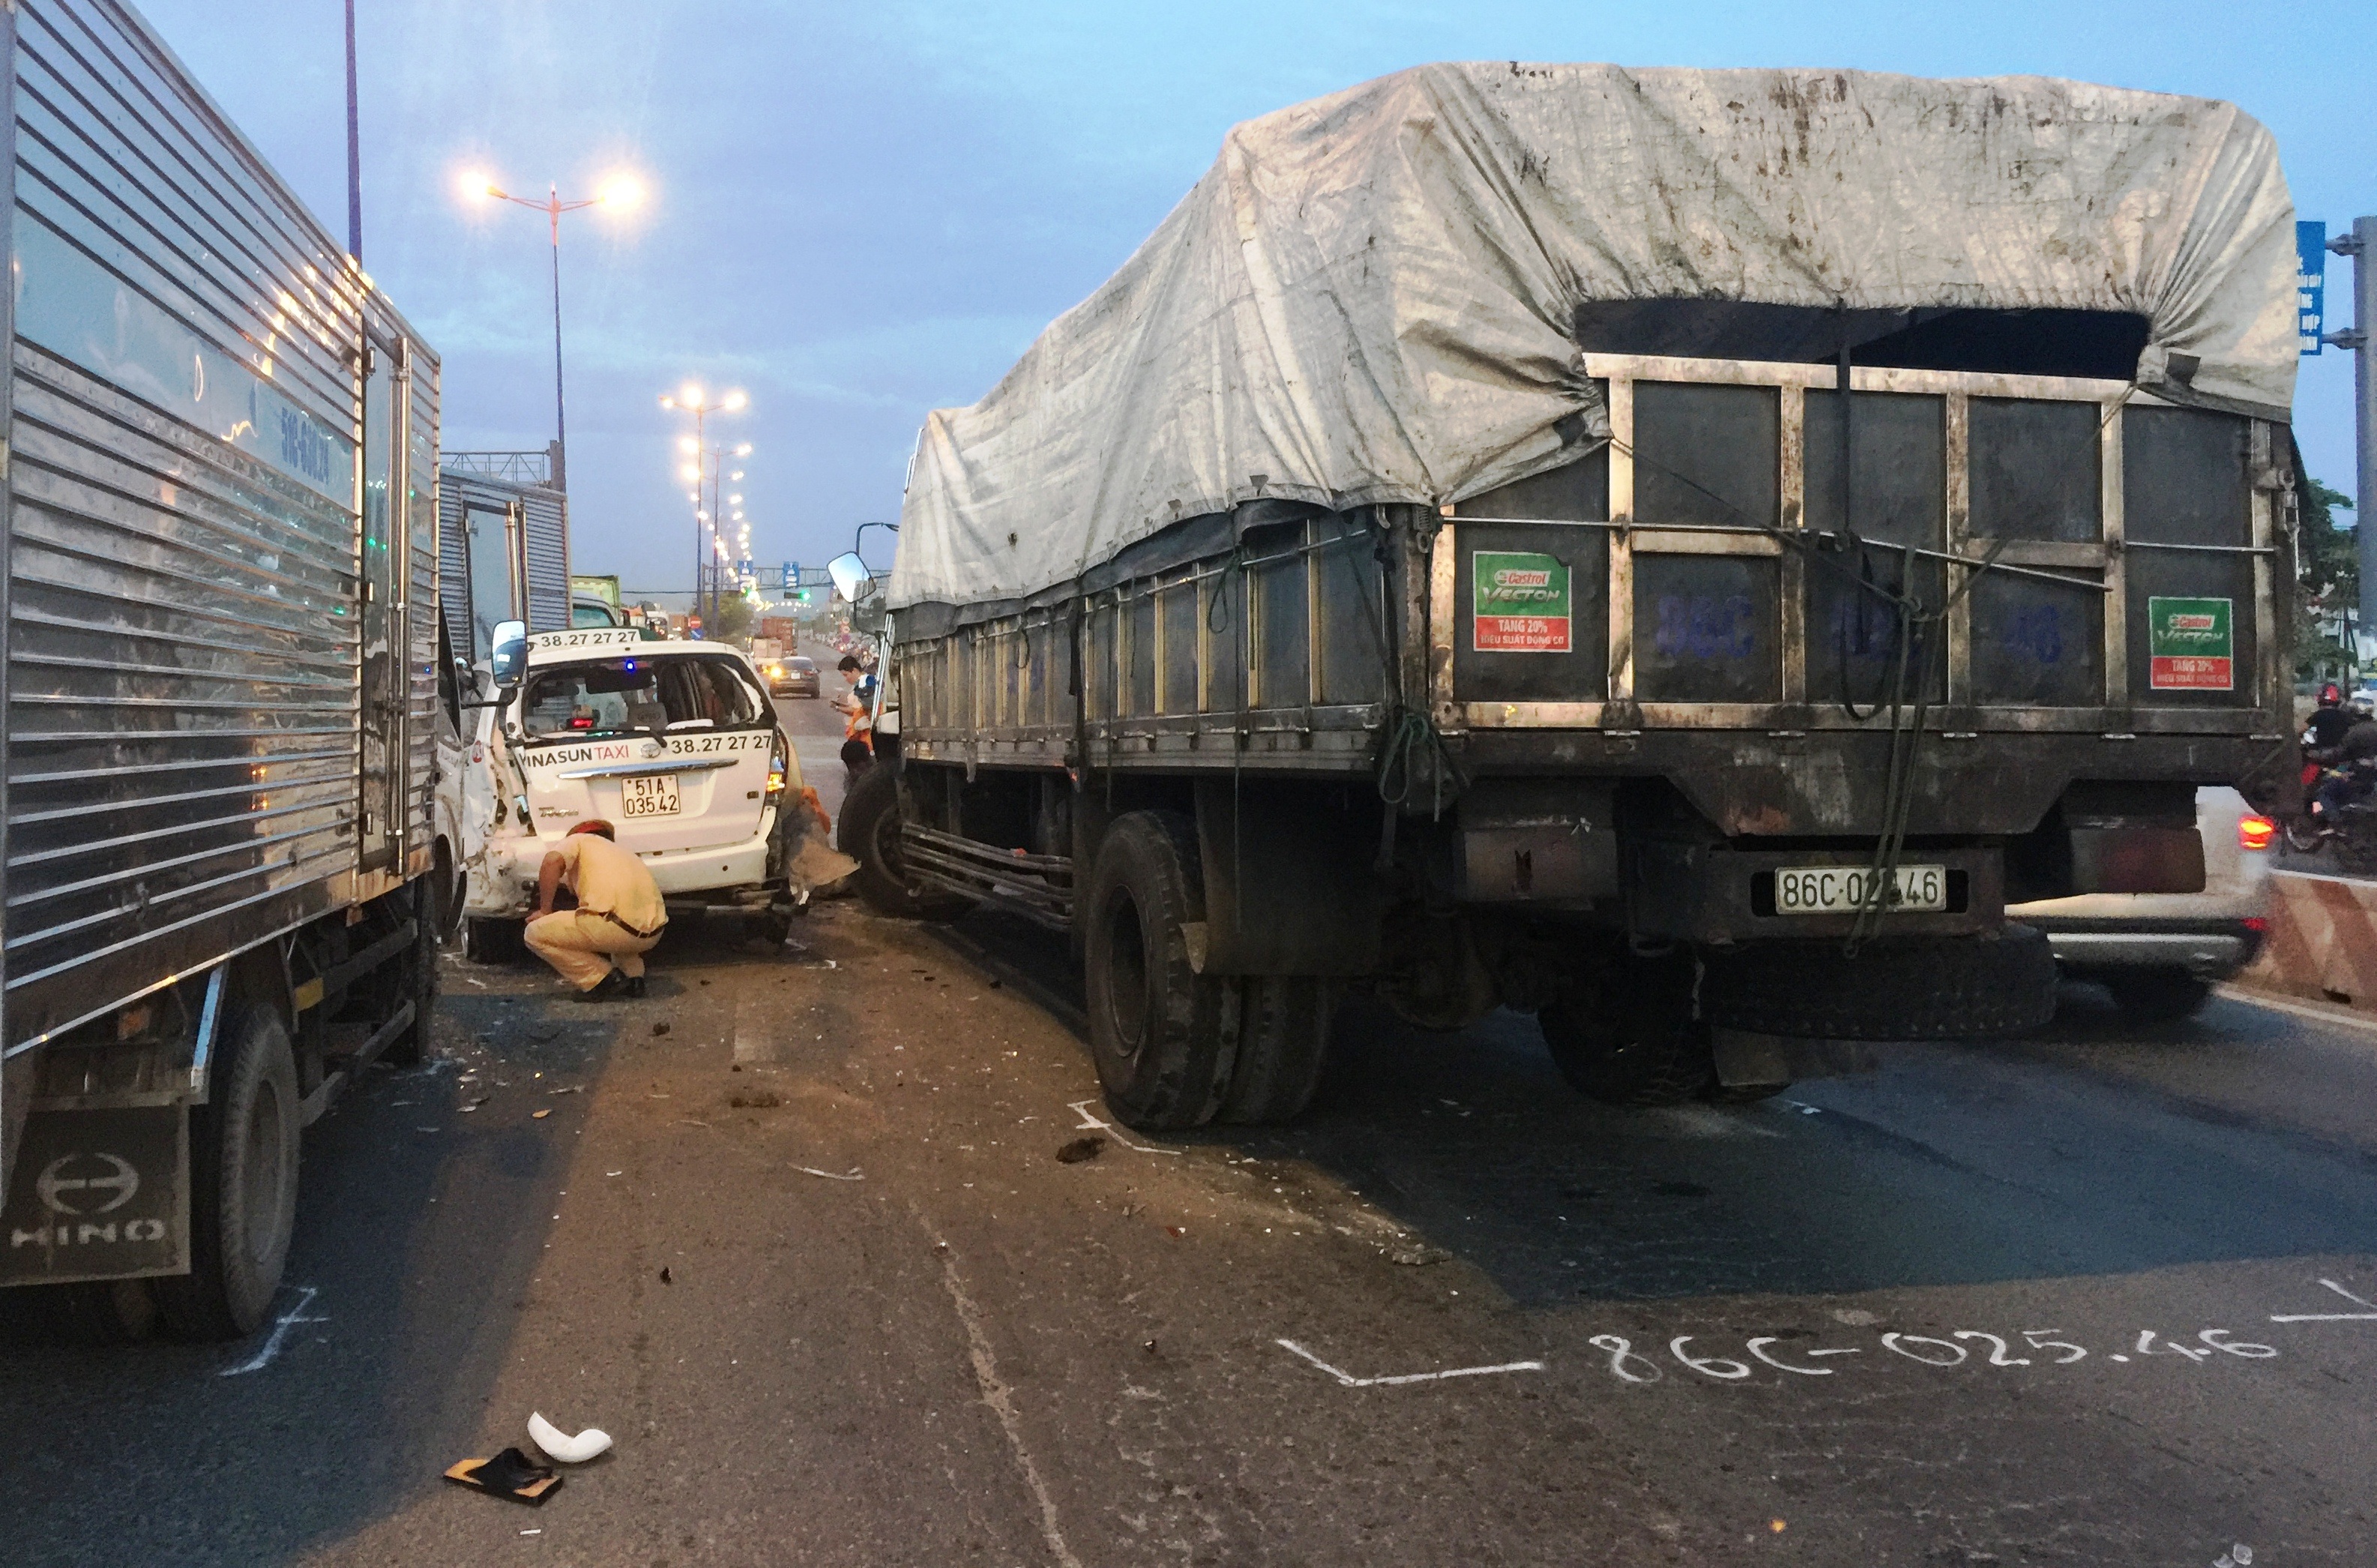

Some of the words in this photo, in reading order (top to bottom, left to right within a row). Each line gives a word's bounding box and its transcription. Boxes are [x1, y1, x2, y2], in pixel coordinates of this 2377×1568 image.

[1507, 572, 1547, 585] Castrol
[1482, 586, 1561, 604] VECTON
[1527, 619, 1548, 633] 20%
[540, 633, 588, 648] 38.27
[593, 633, 612, 645] 27
[618, 631, 637, 643] 27
[594, 744, 630, 760] TAXI
[671, 737, 723, 754] 38.27
[727, 736, 748, 750] 27
[753, 735, 772, 749] 27
[635, 777, 665, 796] 51A
[626, 794, 678, 815] 035.42
[10, 1219, 166, 1249] HINO
